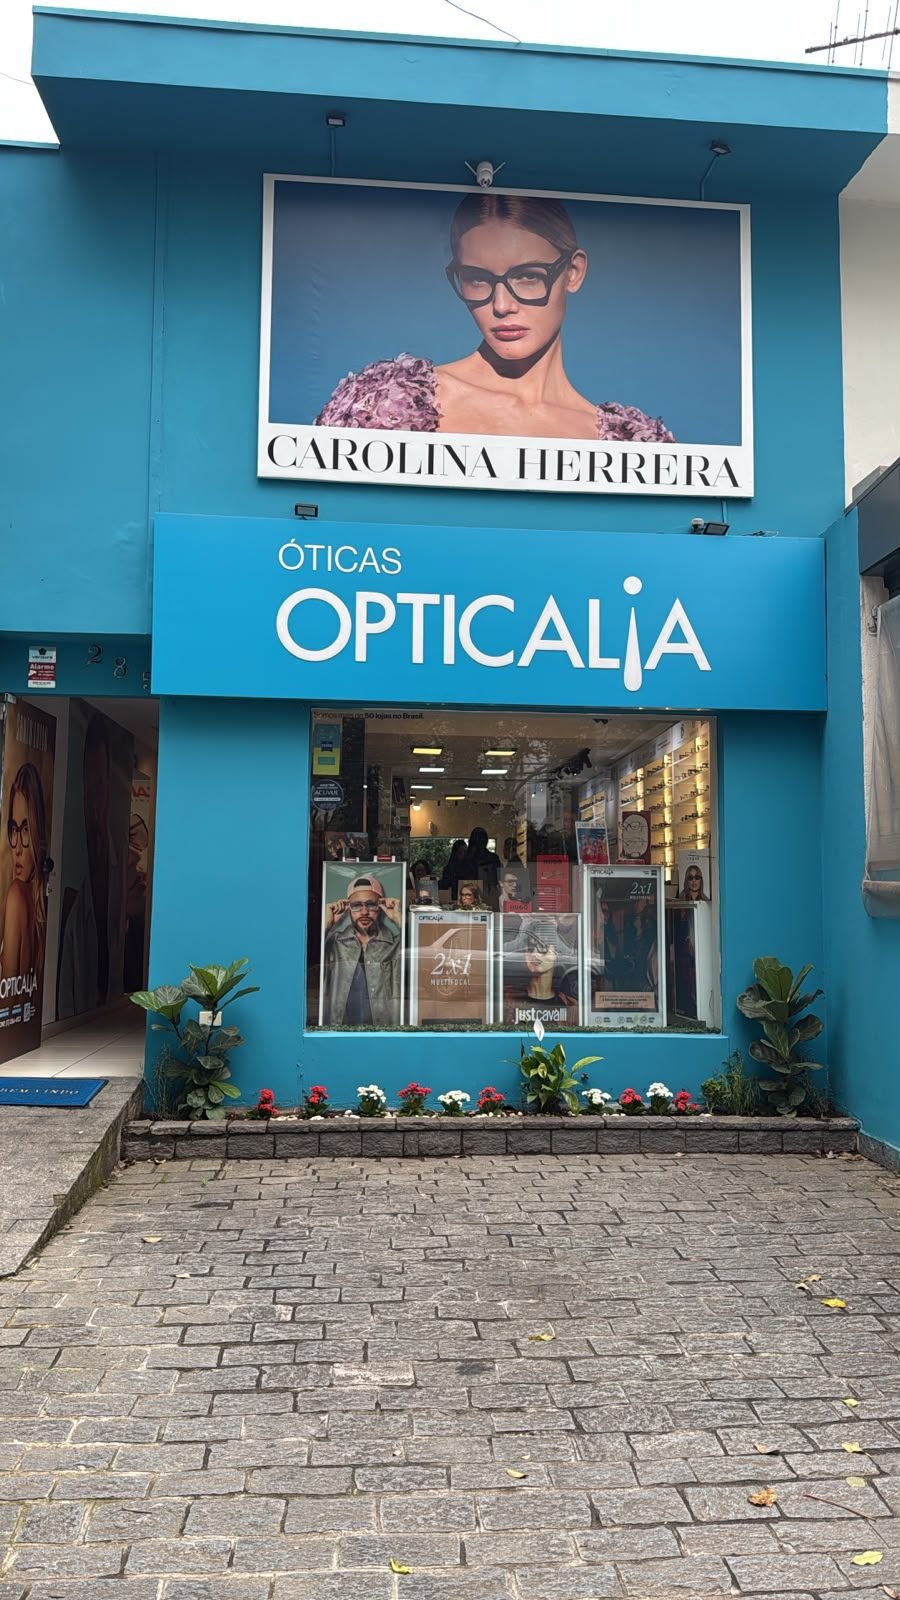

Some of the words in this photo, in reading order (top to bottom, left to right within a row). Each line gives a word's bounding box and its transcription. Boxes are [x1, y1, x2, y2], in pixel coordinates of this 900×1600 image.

[266, 434, 498, 479] CAROLINA
[517, 446, 743, 489] HERRERA
[278, 537, 403, 575] ÓTICAS
[30, 663, 55, 671] Alarme
[375, 712, 392, 720] lojas
[630, 881, 653, 895] 2x1
[430, 952, 473, 976] 2x1
